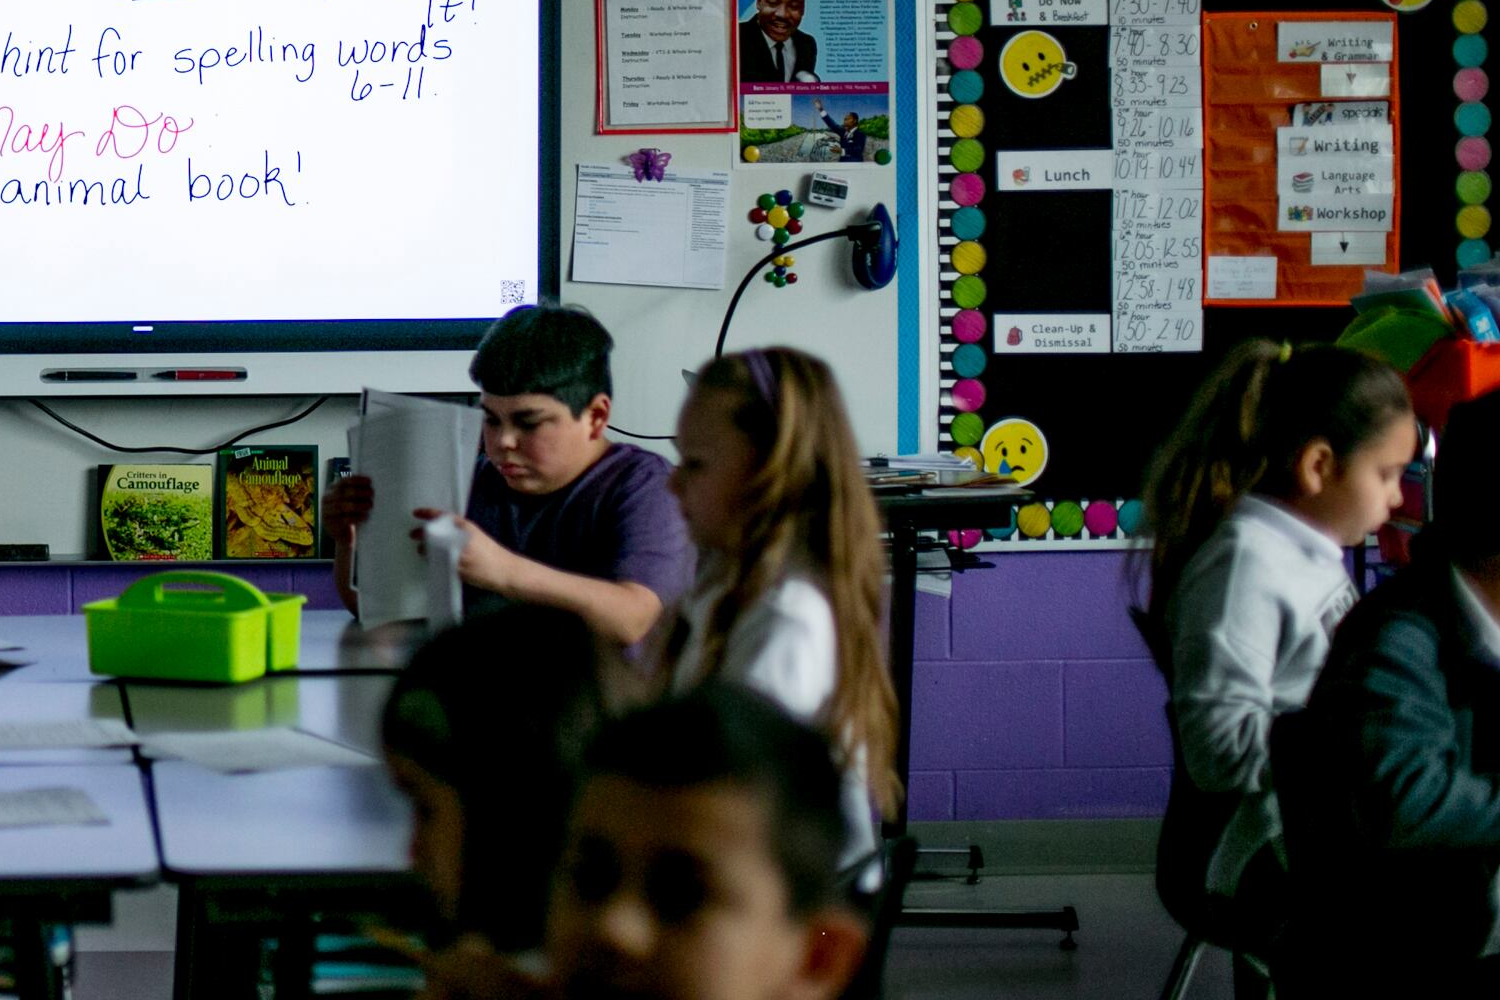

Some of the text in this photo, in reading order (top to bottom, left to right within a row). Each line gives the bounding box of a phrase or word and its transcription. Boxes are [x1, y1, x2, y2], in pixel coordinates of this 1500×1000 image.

[1328, 38, 1373, 50] Writing
[1, 24, 76, 77] hint
[92, 27, 142, 77] for
[174, 26, 315, 84] spelling
[339, 24, 452, 67] words
[97, 105, 193, 158] Do
[1314, 139, 1379, 154] Writing
[0, 164, 150, 206] animal
[188, 150, 310, 206] book!
[1044, 169, 1090, 182] Lunch
[1322, 171, 1375, 183] Language
[1317, 208, 1386, 221] Workshop
[1032, 324, 1084, 335] Clean-Up
[1035, 338, 1092, 347] Dismissal
[251, 456, 289, 471] Animal
[126, 471, 167, 479] Critters in
[239, 471, 301, 487] Camouflage
[116, 478, 200, 493] Camouflage
